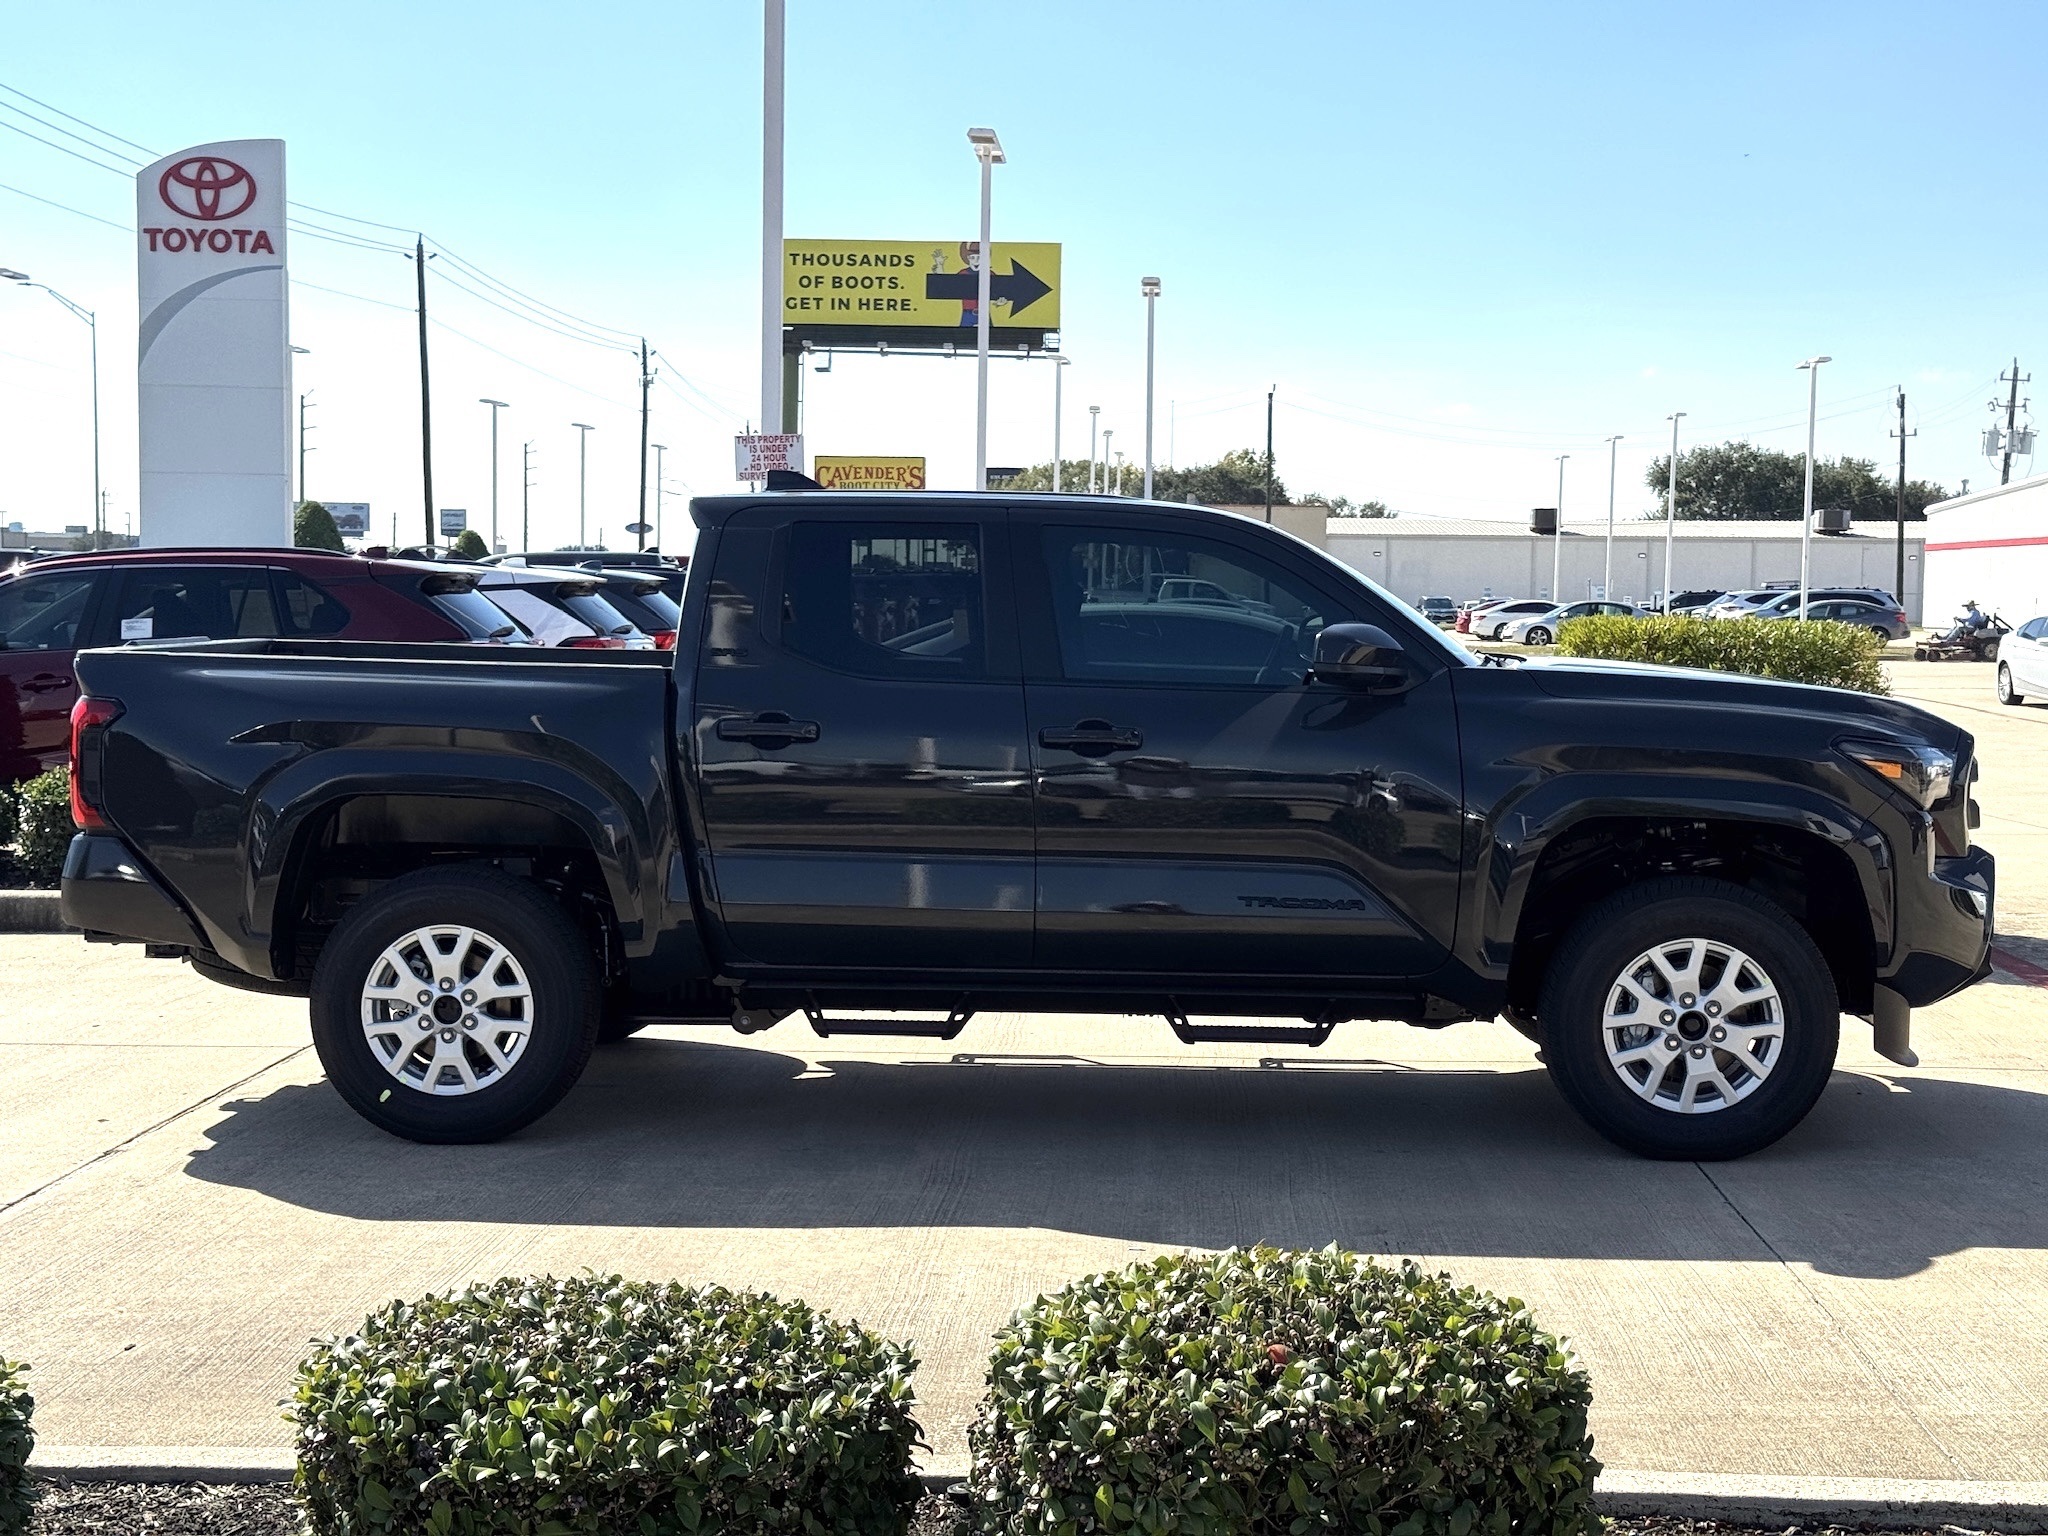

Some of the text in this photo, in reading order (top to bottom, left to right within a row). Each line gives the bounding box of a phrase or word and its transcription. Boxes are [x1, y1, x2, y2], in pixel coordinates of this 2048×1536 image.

[143, 227, 275, 255] TOYOTA
[789, 253, 915, 267] THOUSANDS
[798, 275, 905, 290] OF BOOTS.
[785, 297, 918, 312] GET IN HERE.
[736, 435, 801, 444] THIS PROPERTY
[749, 444, 788, 454] IS UNDER
[751, 453, 787, 463] 24 HOUR
[750, 462, 789, 472] HD VIDEO
[739, 471, 767, 481] SURVE
[816, 465, 924, 489] CAVENDER'S
[1236, 896, 1366, 911] TACOMA
